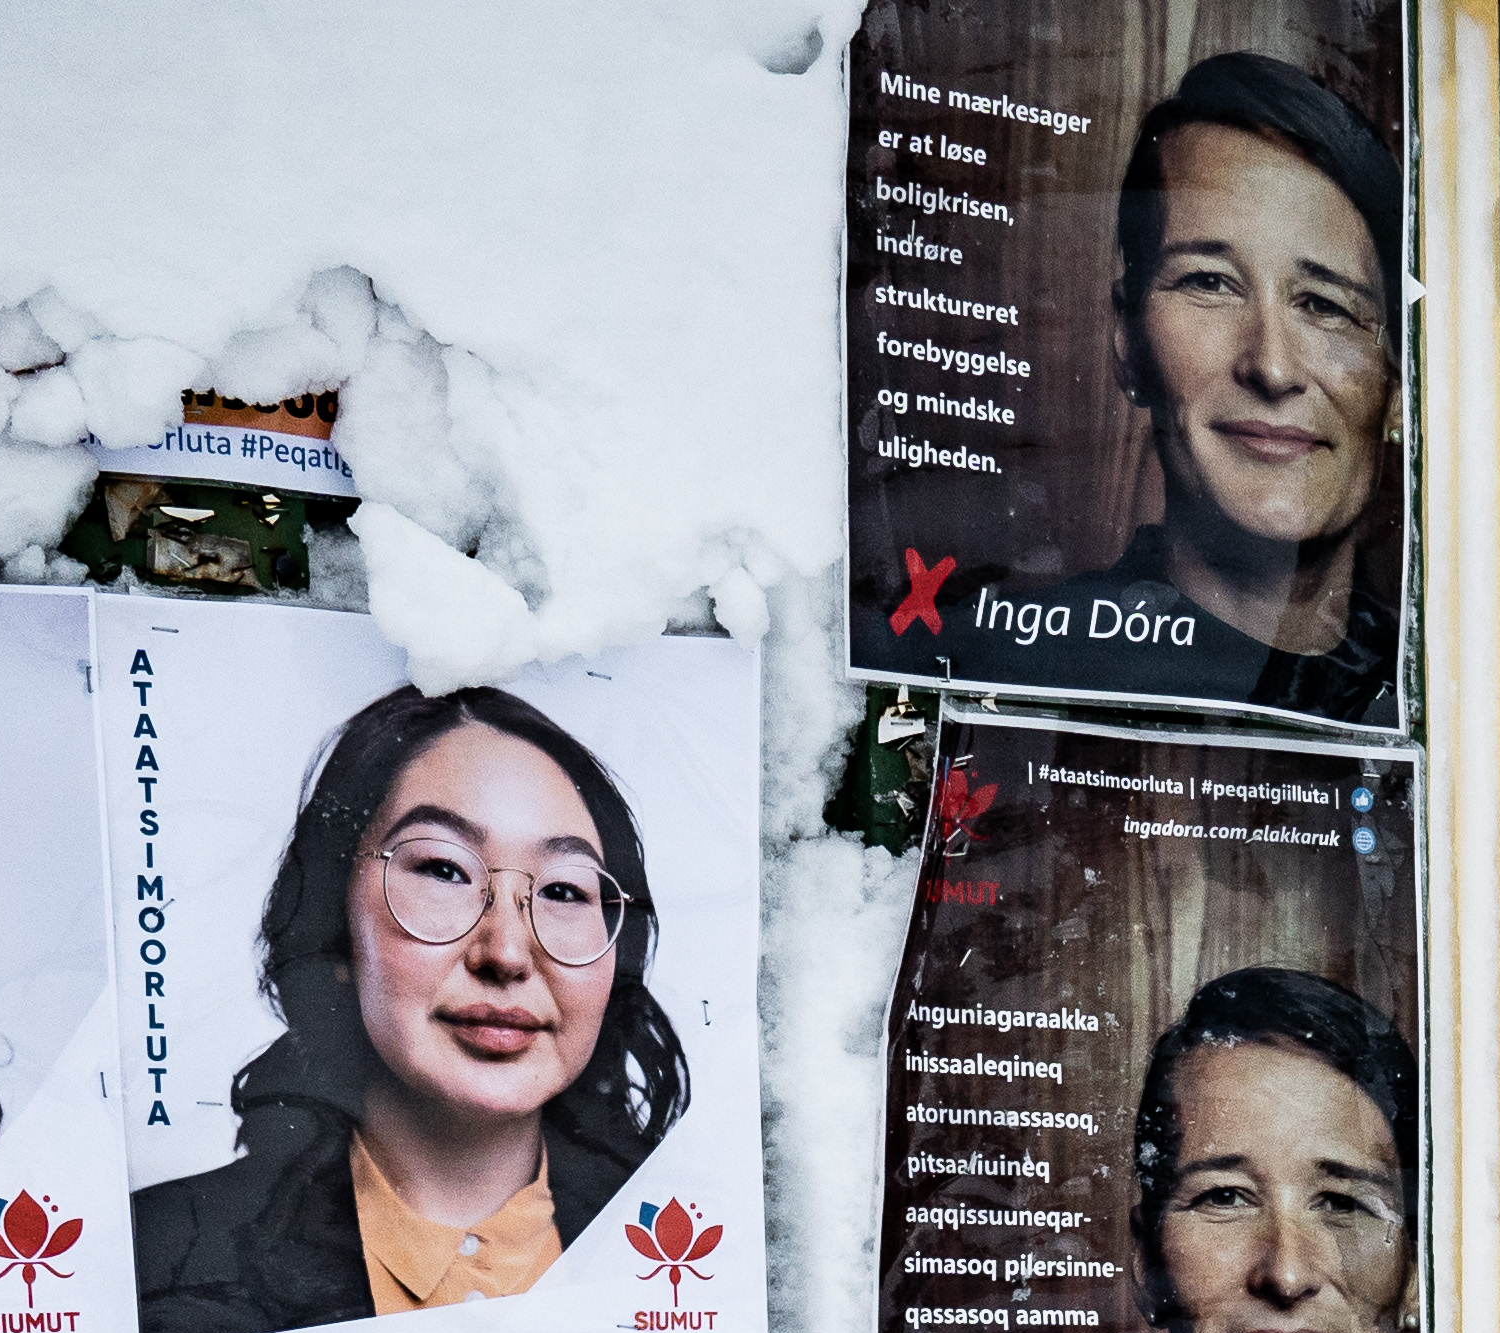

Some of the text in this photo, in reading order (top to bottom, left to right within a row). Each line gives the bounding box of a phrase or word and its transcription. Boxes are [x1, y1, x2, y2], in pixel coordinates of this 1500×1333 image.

[880, 71, 1091, 135] Mine mærkesager
[878, 129, 987, 167] er at løse
[876, 177, 1015, 228] boligkrisen,
[876, 228, 963, 267] indføre
[875, 282, 1019, 326] struktureret
[877, 332, 1031, 377] forebyggelse
[877, 387, 1015, 426] og mindske
[878, 434, 1002, 475] uligheden.
[974, 588, 1197, 647] Inga Dóra
[1039, 765, 1329, 806] #ataatsimoorluta #peqatigiilluta
[1124, 815, 1247, 841] ingadora.com
[129, 650, 172, 1127] ATAATSIMOORLUTA
[907, 1003, 1100, 1033] Anguniagaraakka
[905, 1052, 1063, 1084] inissaaleqineq
[906, 1103, 1100, 1134] atorunnaassasoq,
[905, 1203, 1092, 1235] aaqqissuuneqar-
[904, 1252, 1124, 1282] simasoq pilersinne-
[633, 1311, 718, 1332] SIUMUT
[905, 1305, 1099, 1330] qassasoq aamma
